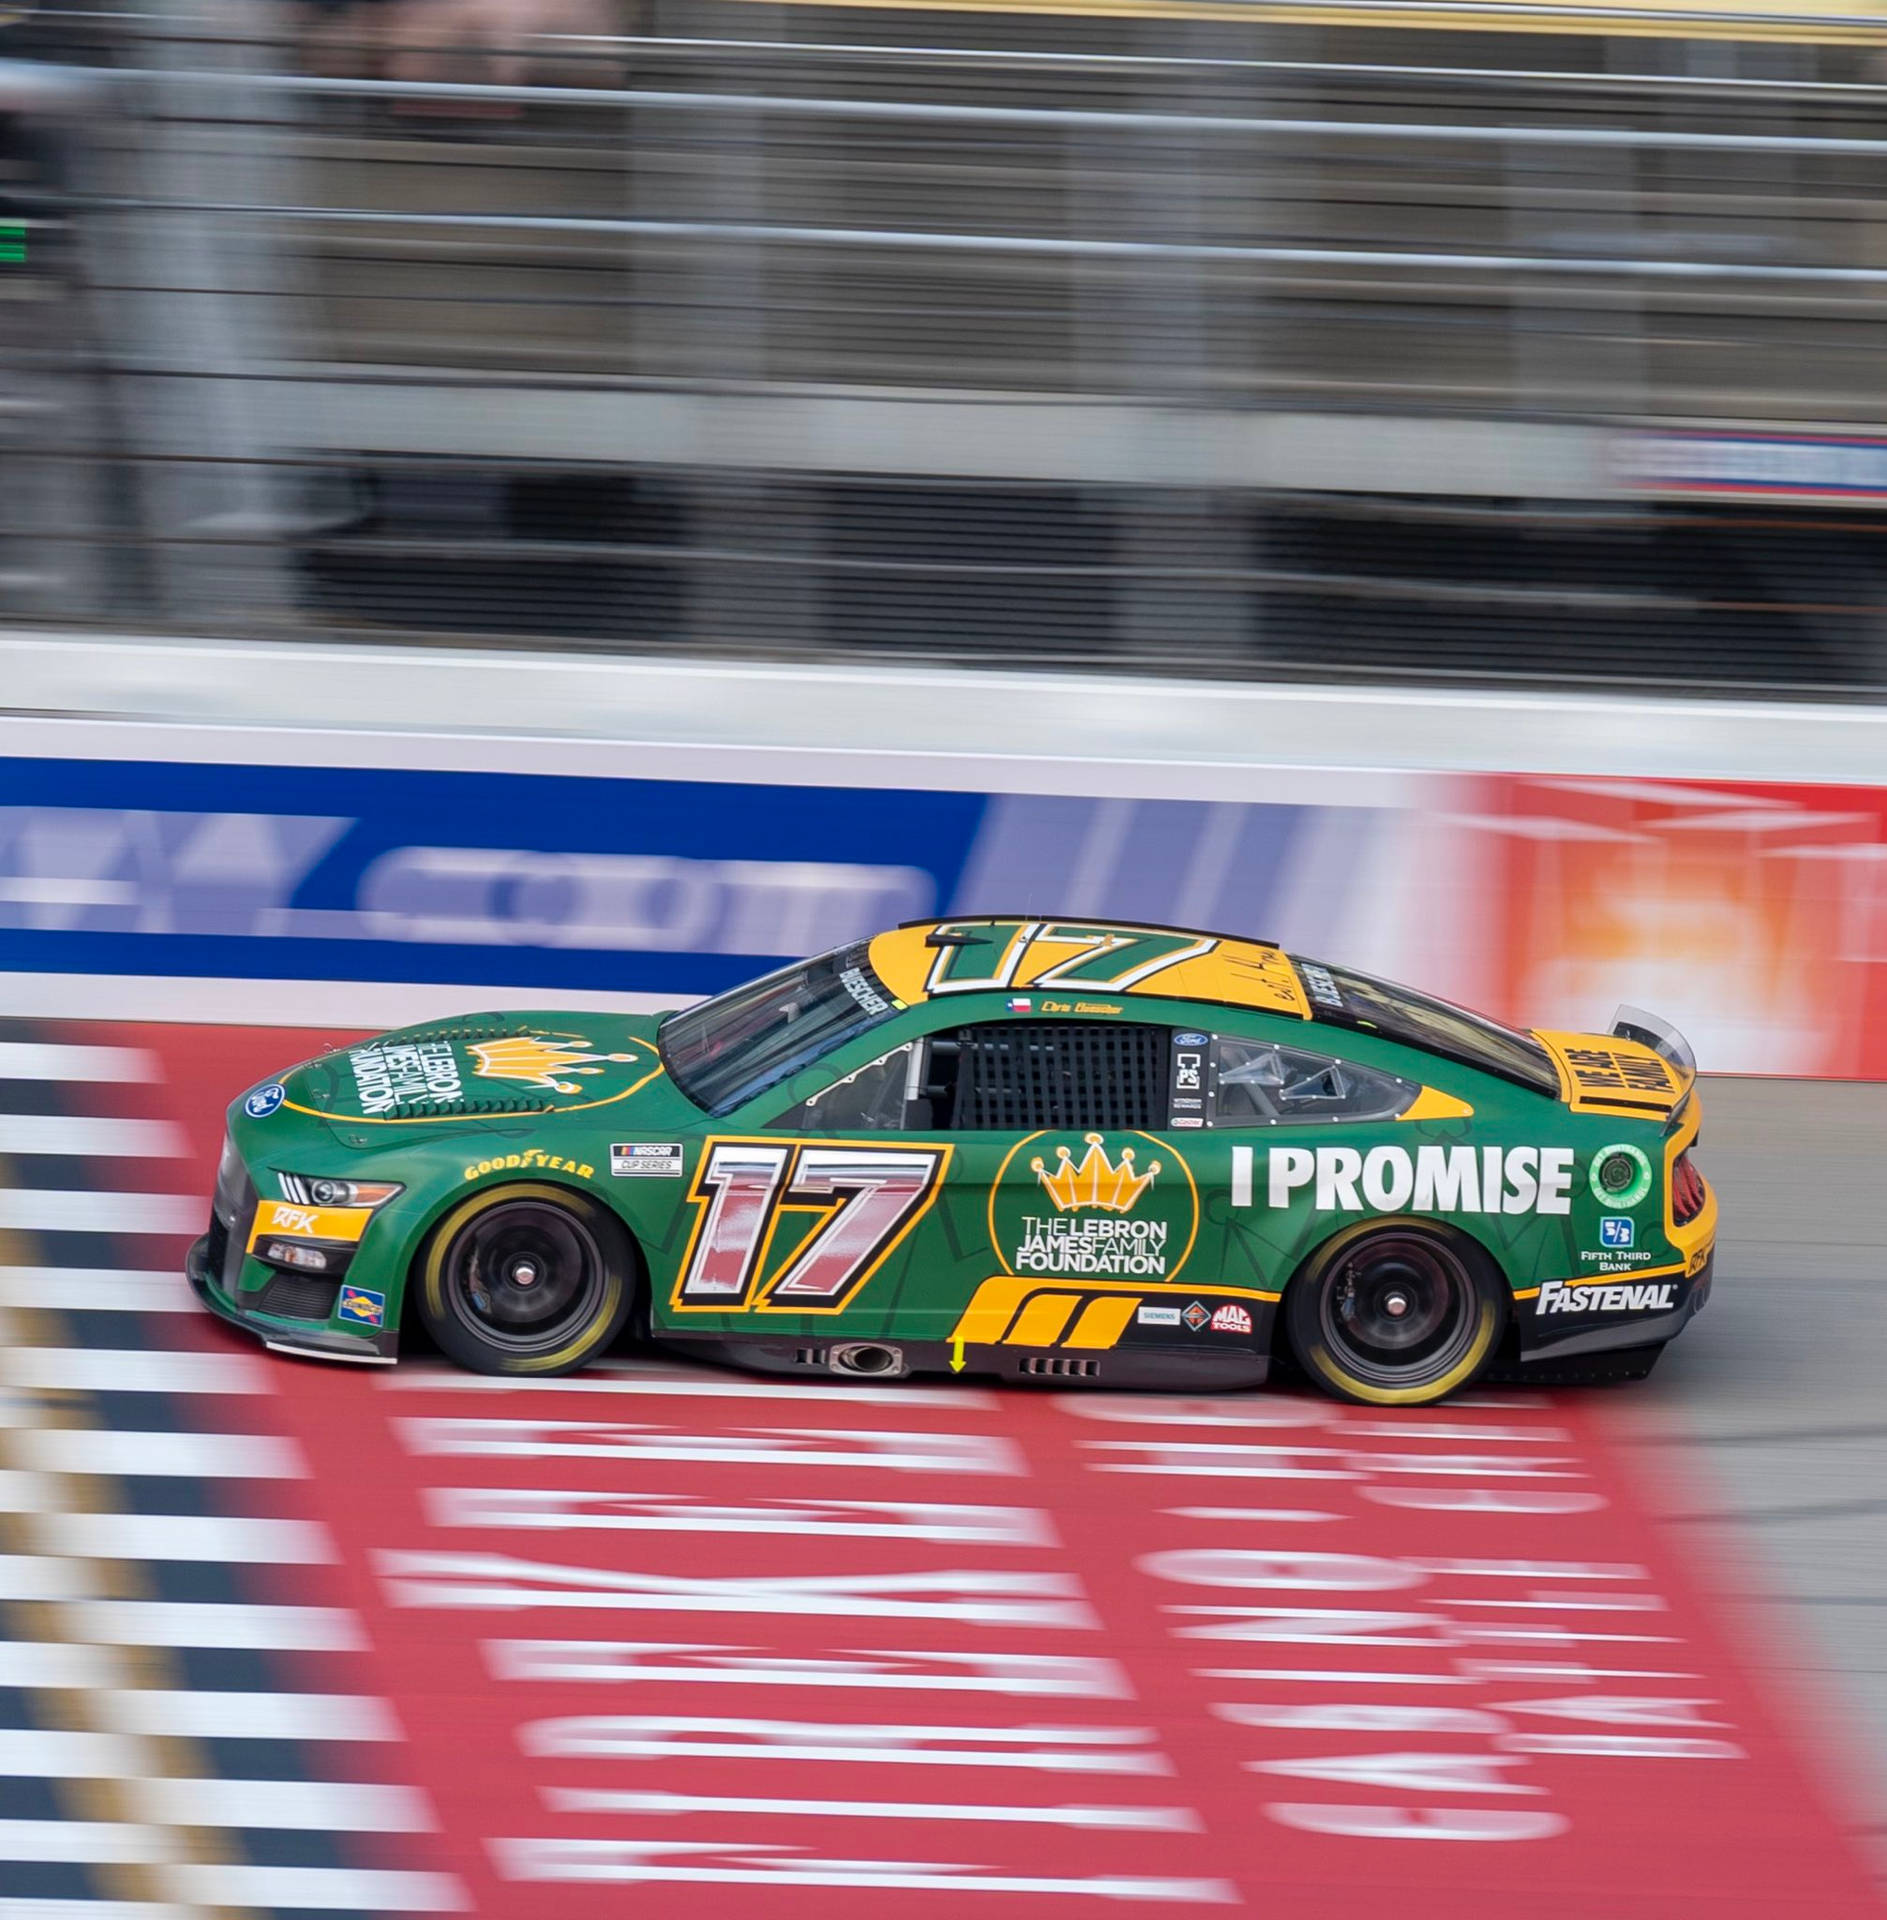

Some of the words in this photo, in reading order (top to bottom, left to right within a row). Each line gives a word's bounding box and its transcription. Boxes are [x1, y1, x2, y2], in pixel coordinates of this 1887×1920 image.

[923, 920, 1221, 993] 17
[839, 967, 889, 1015] BUESCHER
[621, 1160, 639, 1169] CUP
[640, 1160, 673, 1170] SERIES
[1231, 1146, 1253, 1207] I
[1269, 1145, 1574, 1215] PROMISE
[272, 1206, 319, 1234] RFK
[674, 1138, 950, 1312] 17
[1021, 1216, 1068, 1237] THE
[1070, 1219, 1168, 1240] LEBRON
[1015, 1252, 1166, 1275] FOUNDATION
[1581, 1251, 1612, 1261] FIFTH
[1617, 1252, 1652, 1261] THIRD
[1599, 1262, 1632, 1271] BANK
[1143, 1312, 1176, 1320] SIEMENS
[1213, 1305, 1251, 1324] MAC
[1214, 1322, 1251, 1333] TOOLS
